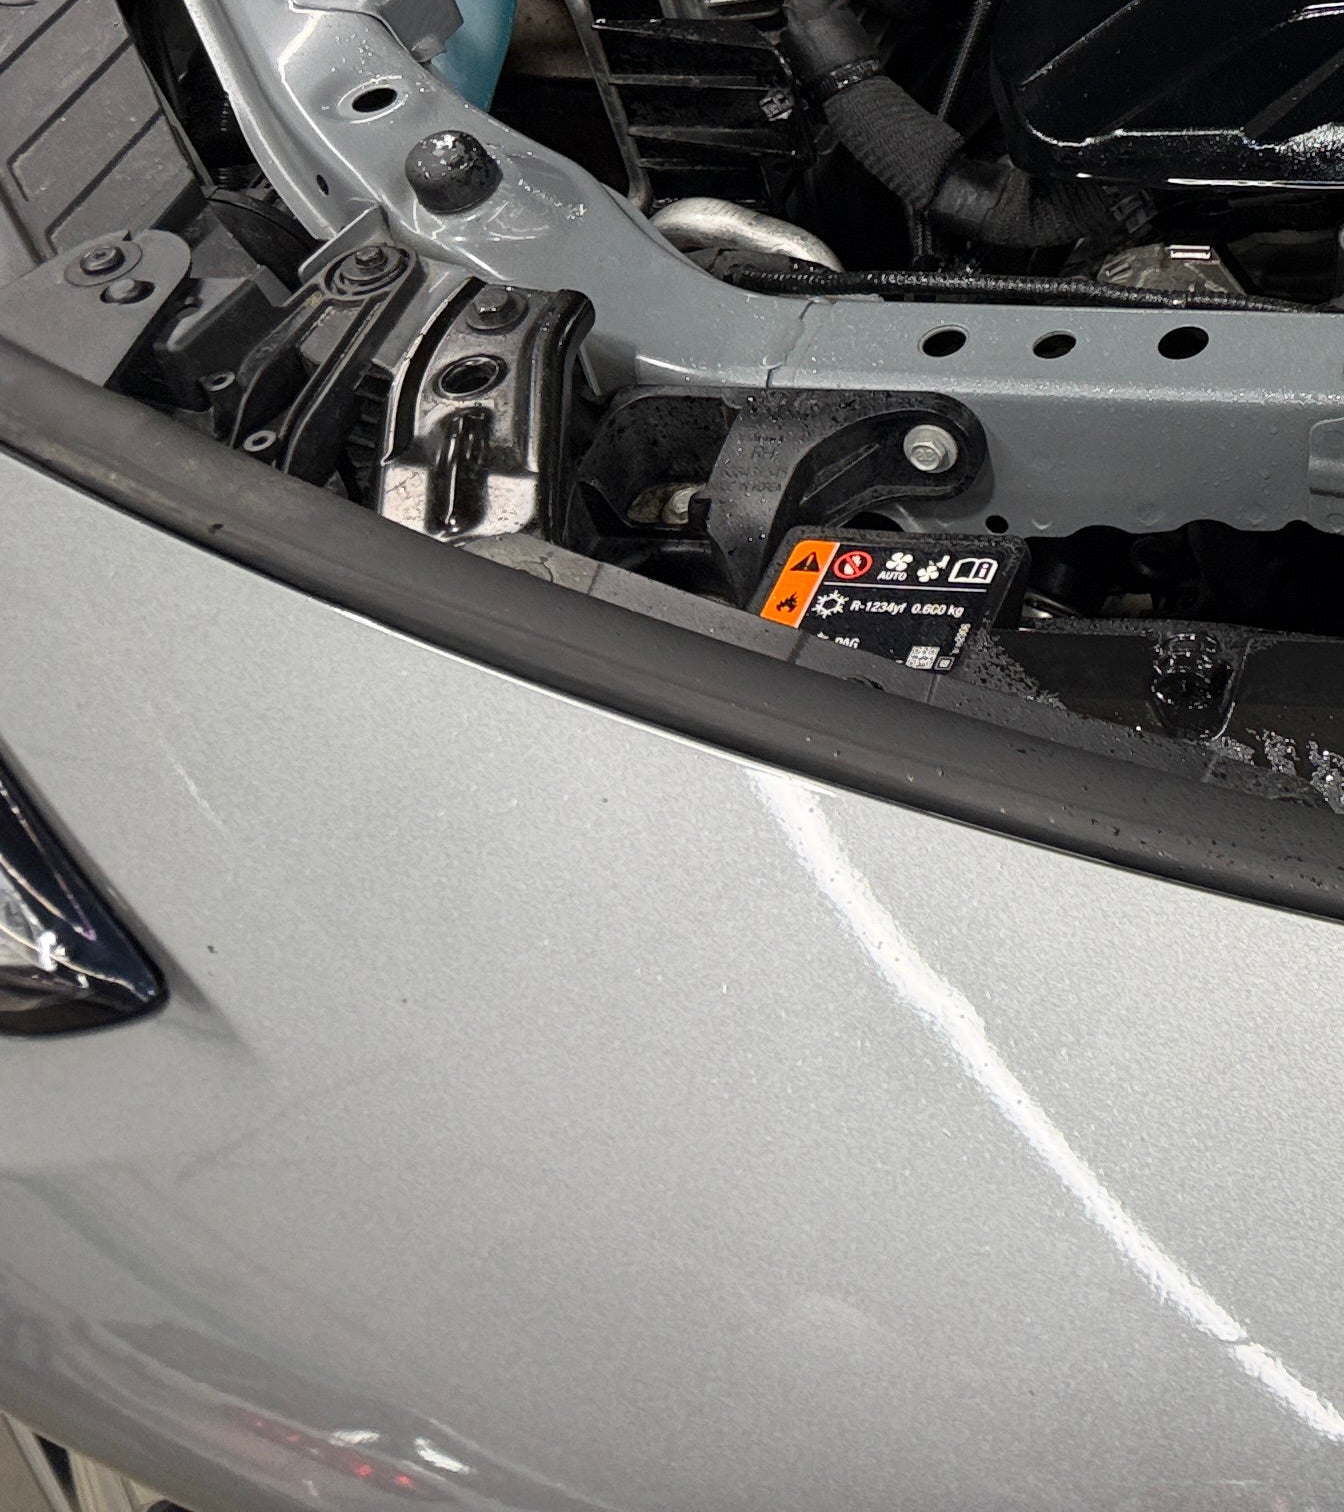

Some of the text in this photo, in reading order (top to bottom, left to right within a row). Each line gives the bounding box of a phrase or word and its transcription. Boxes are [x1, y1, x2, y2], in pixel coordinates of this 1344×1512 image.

[877, 571, 908, 582] AUTO
[849, 600, 908, 616] R-1234yf
[946, 605, 965, 619] kg
